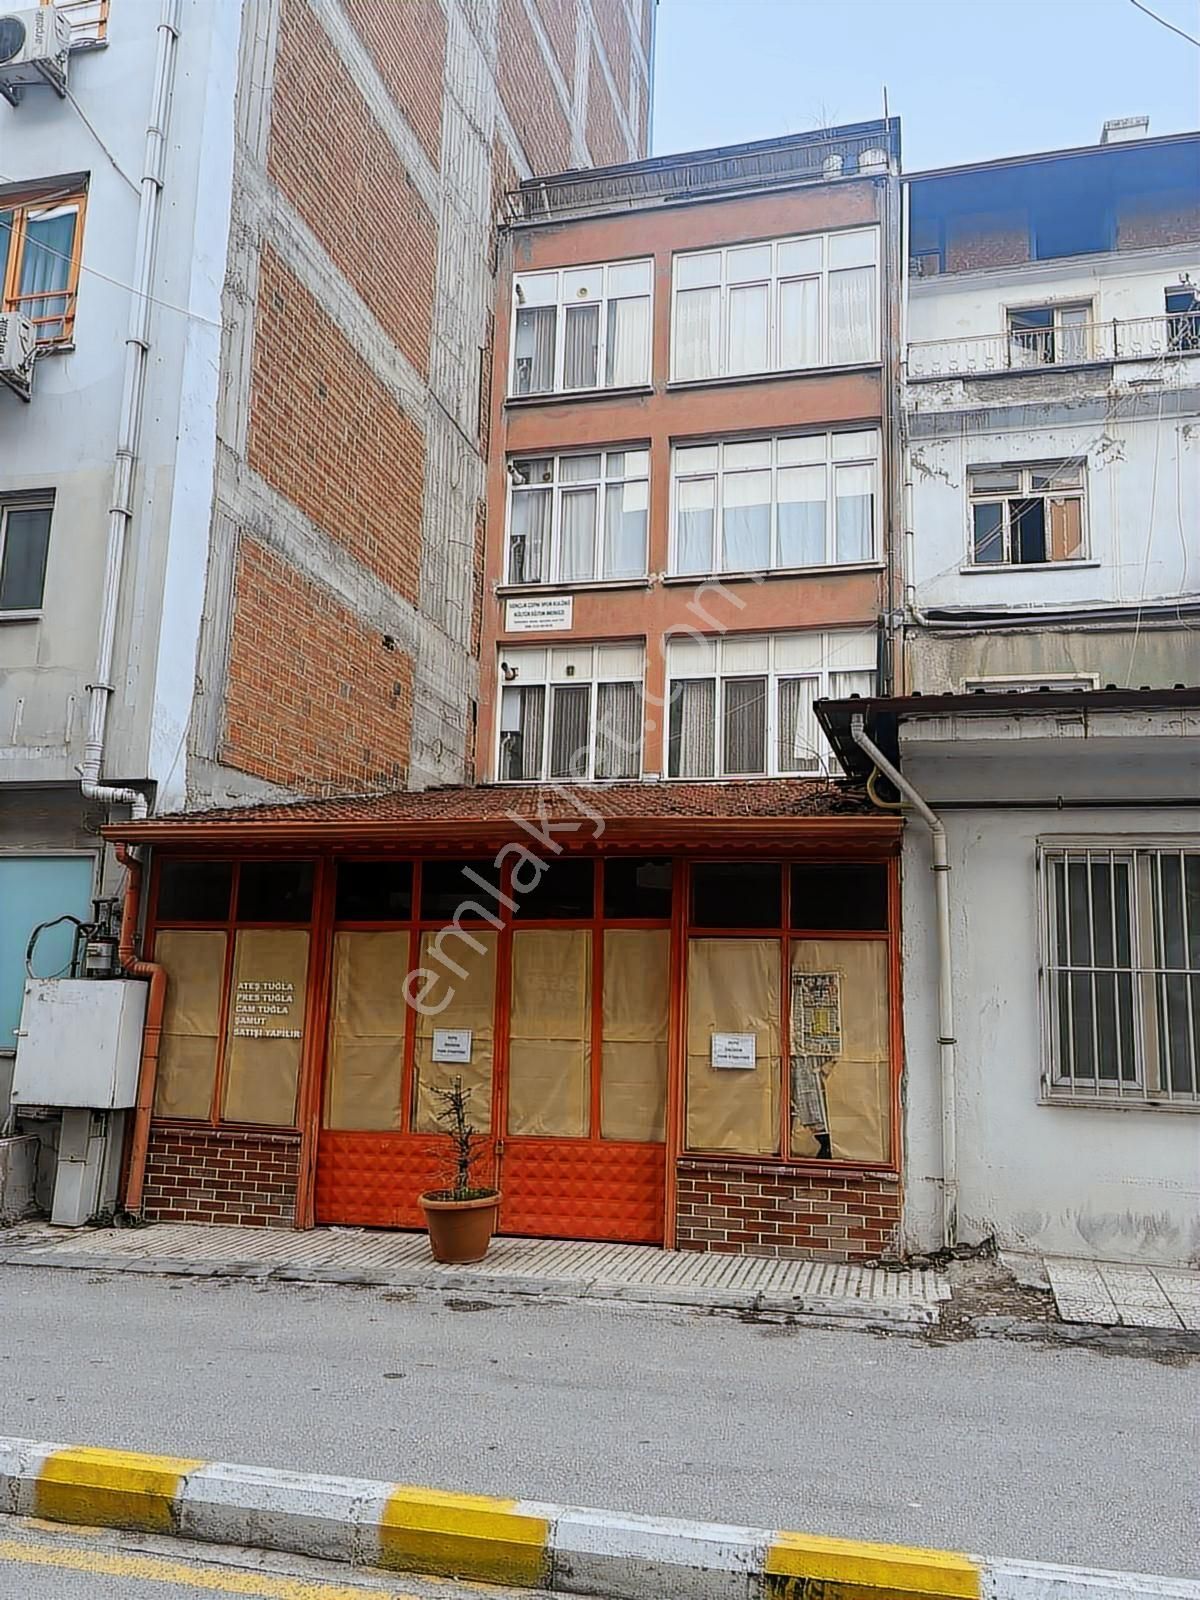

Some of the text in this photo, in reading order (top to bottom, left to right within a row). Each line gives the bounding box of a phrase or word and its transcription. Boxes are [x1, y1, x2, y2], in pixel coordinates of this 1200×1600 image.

[237, 982, 293, 991] ATEŞ TUĞLA
[236, 993, 293, 1002] PRES TUĞLA
[258, 1005, 288, 1014] TUĞLA
